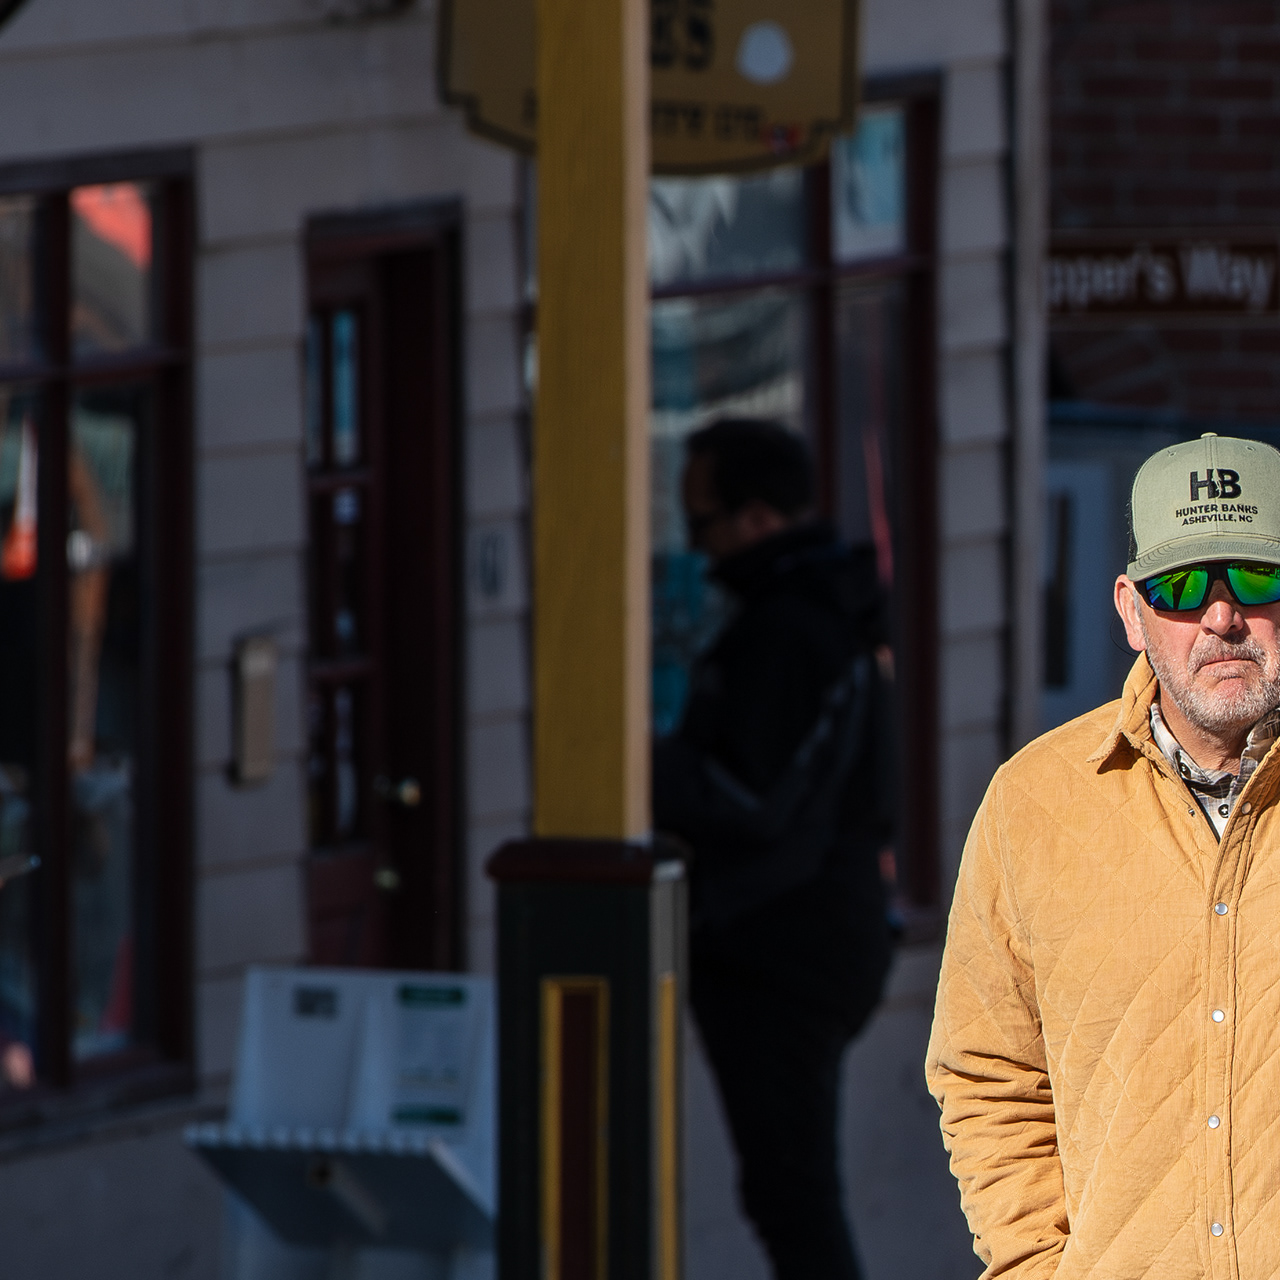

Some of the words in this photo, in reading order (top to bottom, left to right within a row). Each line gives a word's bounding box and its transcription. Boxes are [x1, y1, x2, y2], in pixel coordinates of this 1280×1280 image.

[1046, 243, 1178, 311] pper's
[1180, 243, 1276, 311] Way
[1190, 468, 1242, 501] HB
[1176, 504, 1219, 518] HUNTER
[1221, 504, 1258, 515] BANKS
[1181, 514, 1237, 526] ASHEVILLE,
[1239, 515, 1253, 523] NC
